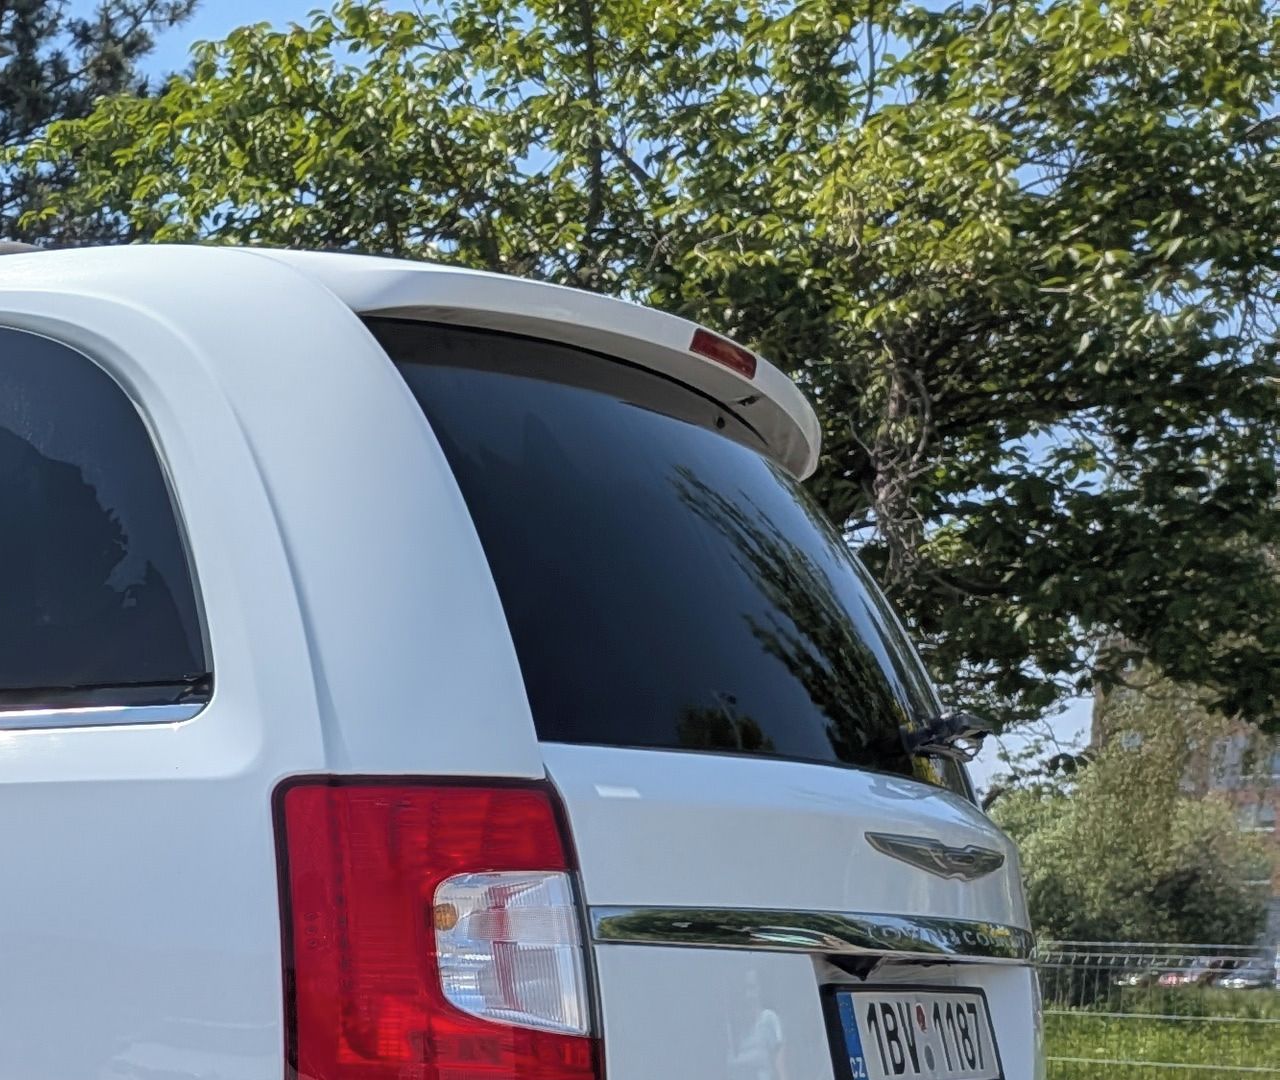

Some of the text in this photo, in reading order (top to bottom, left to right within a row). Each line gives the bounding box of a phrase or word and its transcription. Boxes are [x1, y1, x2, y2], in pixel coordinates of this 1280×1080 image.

[866, 1001, 985, 1076] 1BV 1187
[849, 1056, 866, 1079] CZ
